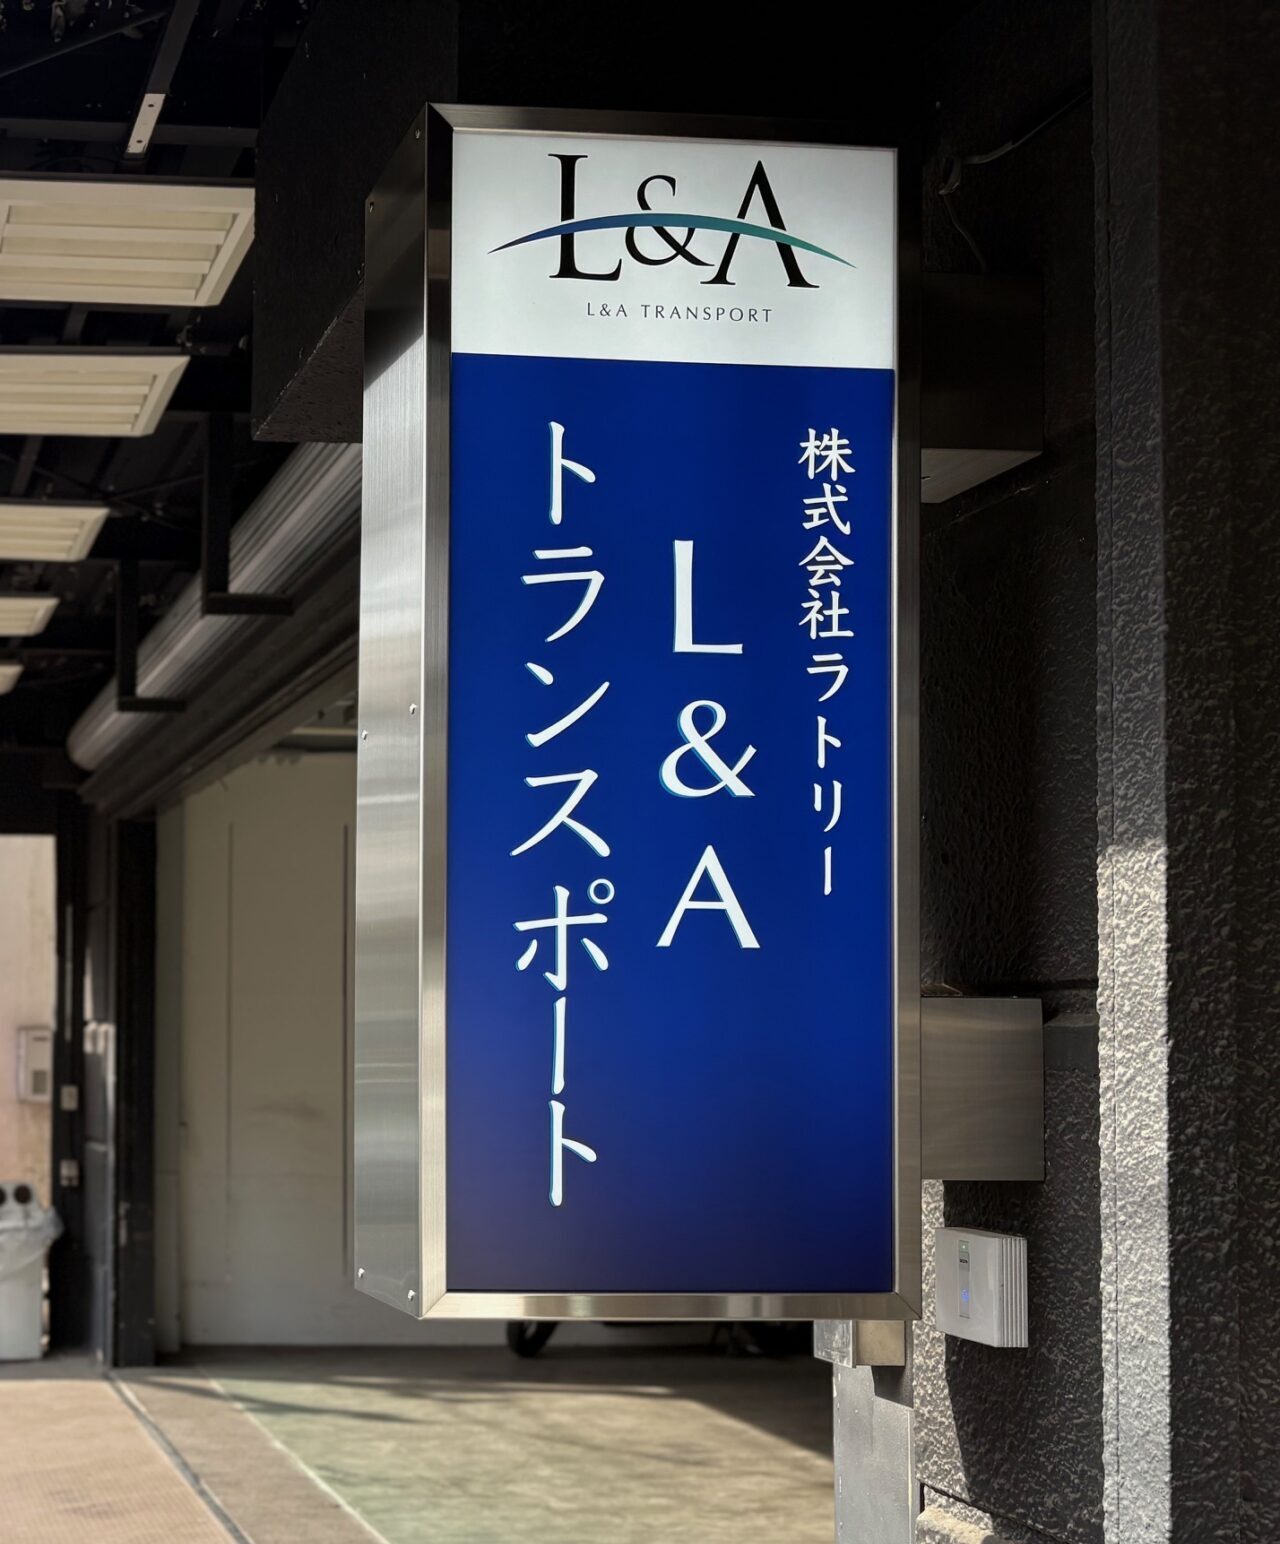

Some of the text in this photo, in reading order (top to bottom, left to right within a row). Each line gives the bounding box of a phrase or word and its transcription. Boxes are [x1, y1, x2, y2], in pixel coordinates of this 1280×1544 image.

[547, 152, 820, 289] L&A
[586, 301, 773, 323] L&A TRANSPORT
[797, 427, 856, 896] 株式会社ラトリー
[509, 420, 615, 1208] トランスポート
